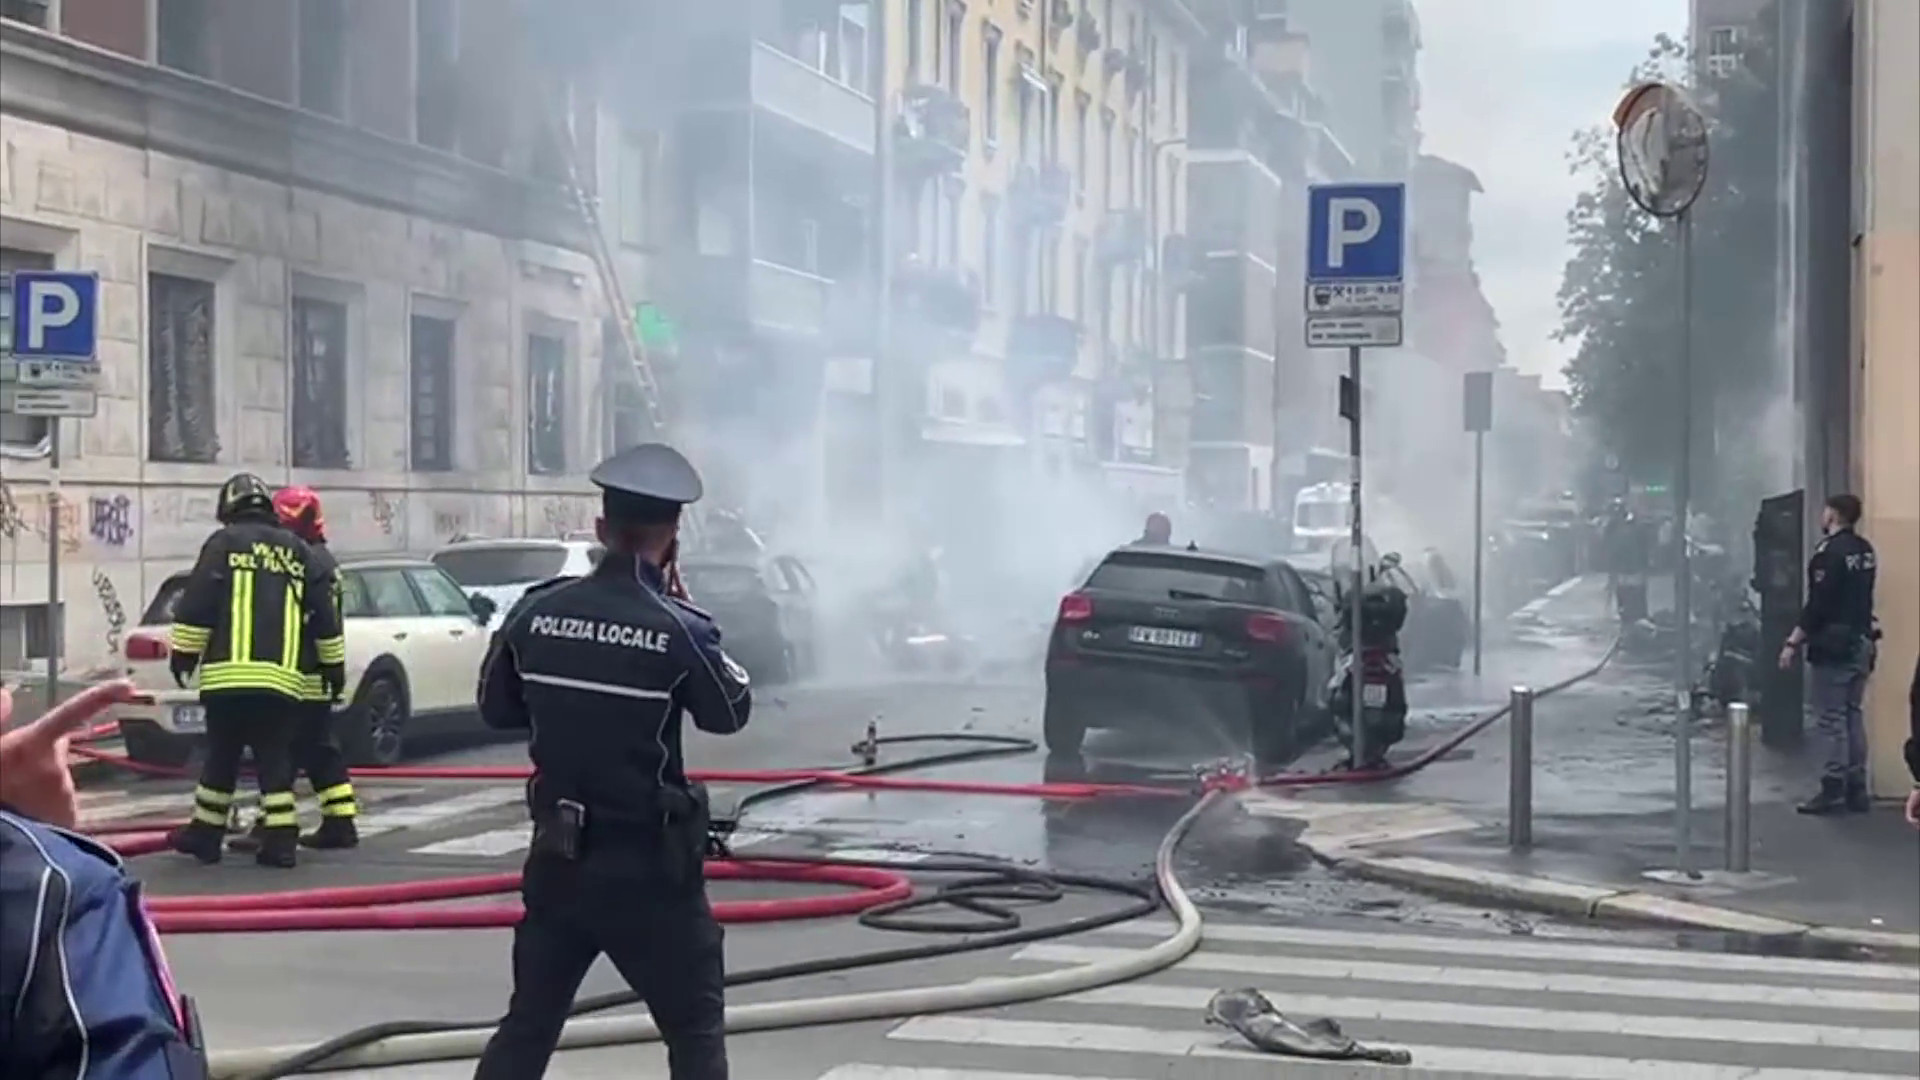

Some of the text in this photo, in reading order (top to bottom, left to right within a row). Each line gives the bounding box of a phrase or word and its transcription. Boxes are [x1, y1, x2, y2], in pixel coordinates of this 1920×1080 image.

[1328, 198, 1381, 267] P
[28, 281, 80, 347] P
[228, 552, 257, 568] DEL
[530, 615, 670, 653] POLIZIA LOCALE
